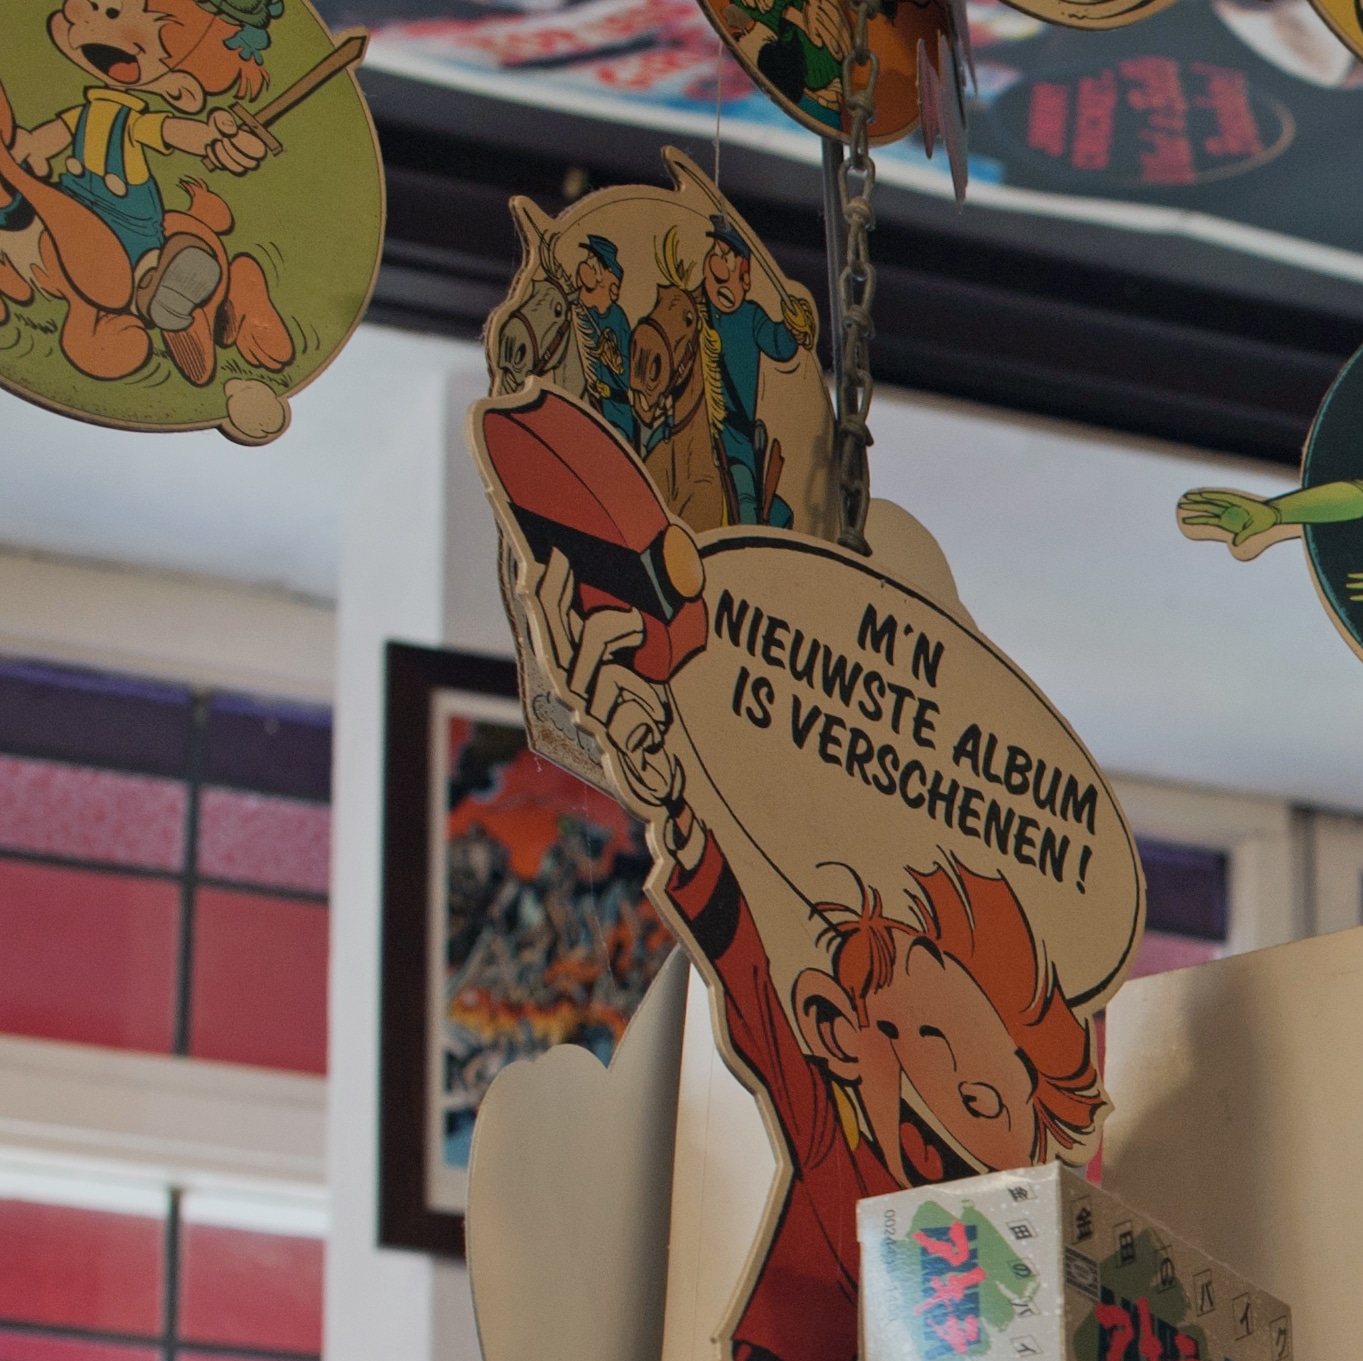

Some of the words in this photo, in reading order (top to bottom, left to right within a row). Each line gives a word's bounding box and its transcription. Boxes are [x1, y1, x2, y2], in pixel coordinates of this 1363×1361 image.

[857, 602, 945, 689] M'N
[713, 588, 941, 750] NIEUWSTE
[951, 723, 1099, 836] ALBUM
[731, 665, 775, 729] IS
